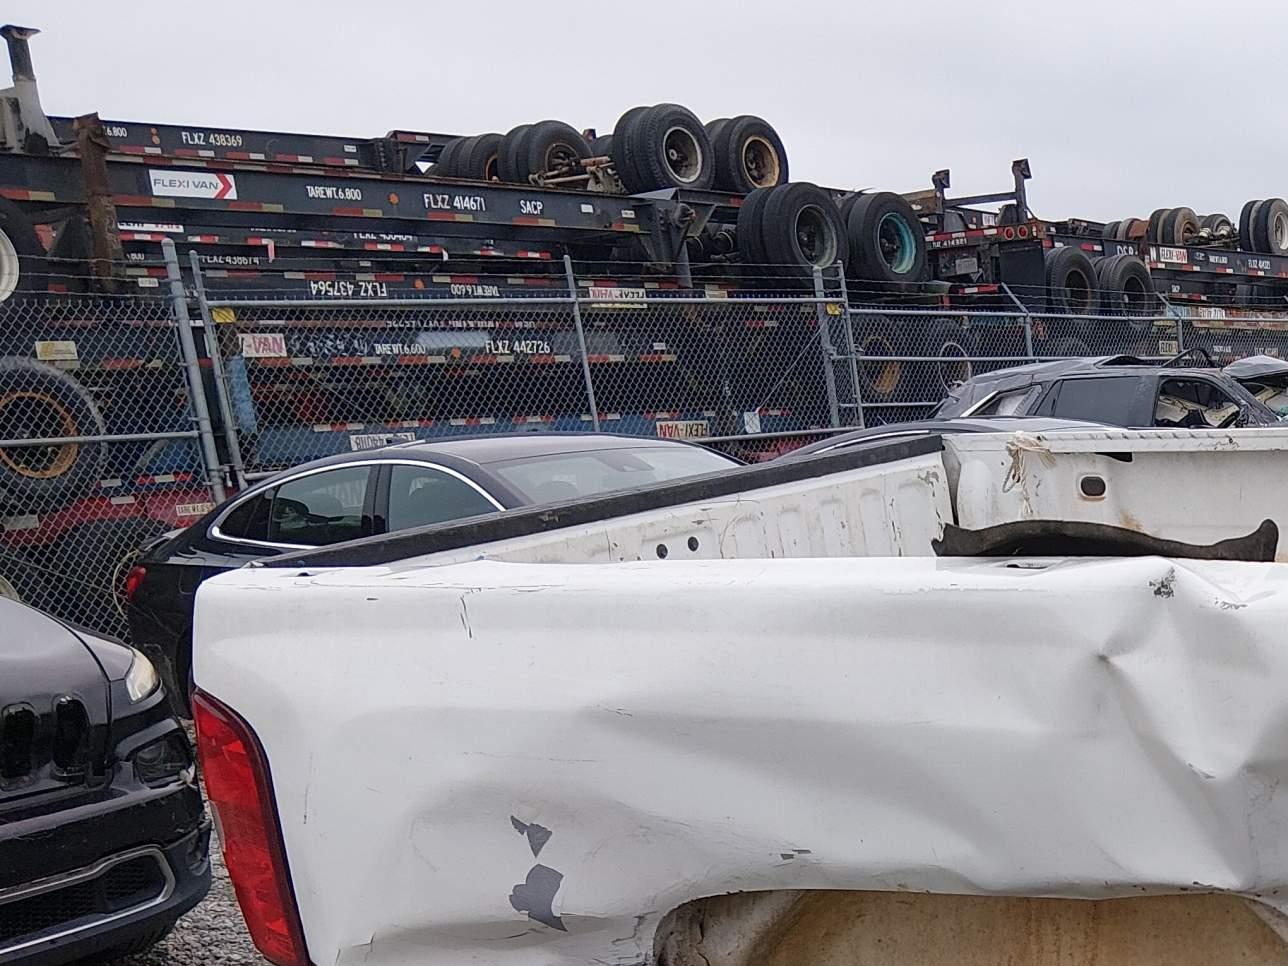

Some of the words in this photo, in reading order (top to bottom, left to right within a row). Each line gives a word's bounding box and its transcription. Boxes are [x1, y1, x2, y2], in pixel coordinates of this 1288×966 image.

[181, 132, 206, 146] FLXZ
[208, 134, 242, 147] 438369
[153, 178, 190, 189] FLEXI
[192, 180, 219, 190] VAN
[424, 193, 451, 209] FLXZ
[453, 195, 486, 212] 414671
[519, 199, 543, 215] SACP
[310, 280, 355, 297] 437564
[358, 281, 388, 297] FLXZ
[485, 340, 510, 354] FLXZ
[513, 340, 551, 354] 442726
